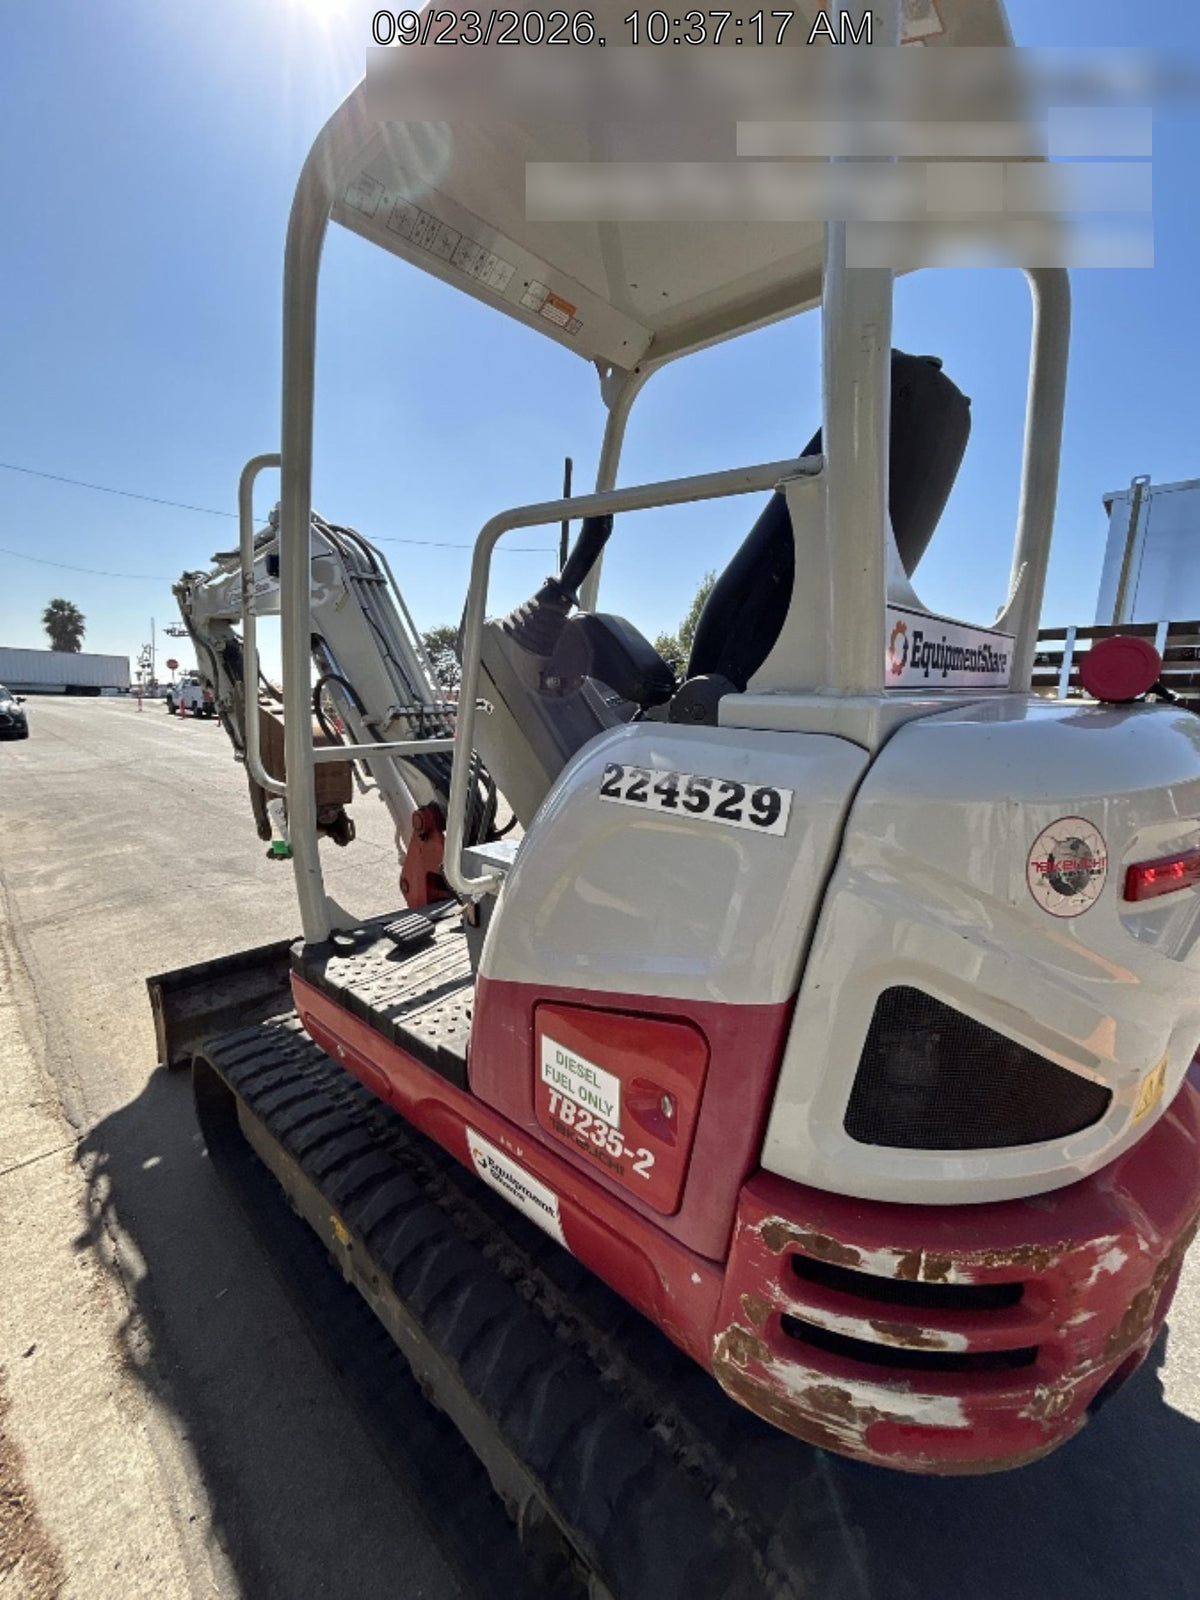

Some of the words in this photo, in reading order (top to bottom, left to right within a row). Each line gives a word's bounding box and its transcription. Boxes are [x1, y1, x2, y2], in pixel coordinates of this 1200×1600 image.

[910, 630, 1007, 678] EquipmentShare
[600, 763, 782, 827] 224529
[545, 1064, 575, 1094] FUEL
[578, 1085, 614, 1118] ONLY
[556, 1050, 601, 1089] DIESEL
[548, 1088, 655, 1180] TB235-2
[487, 1155, 556, 1219] Equipment
